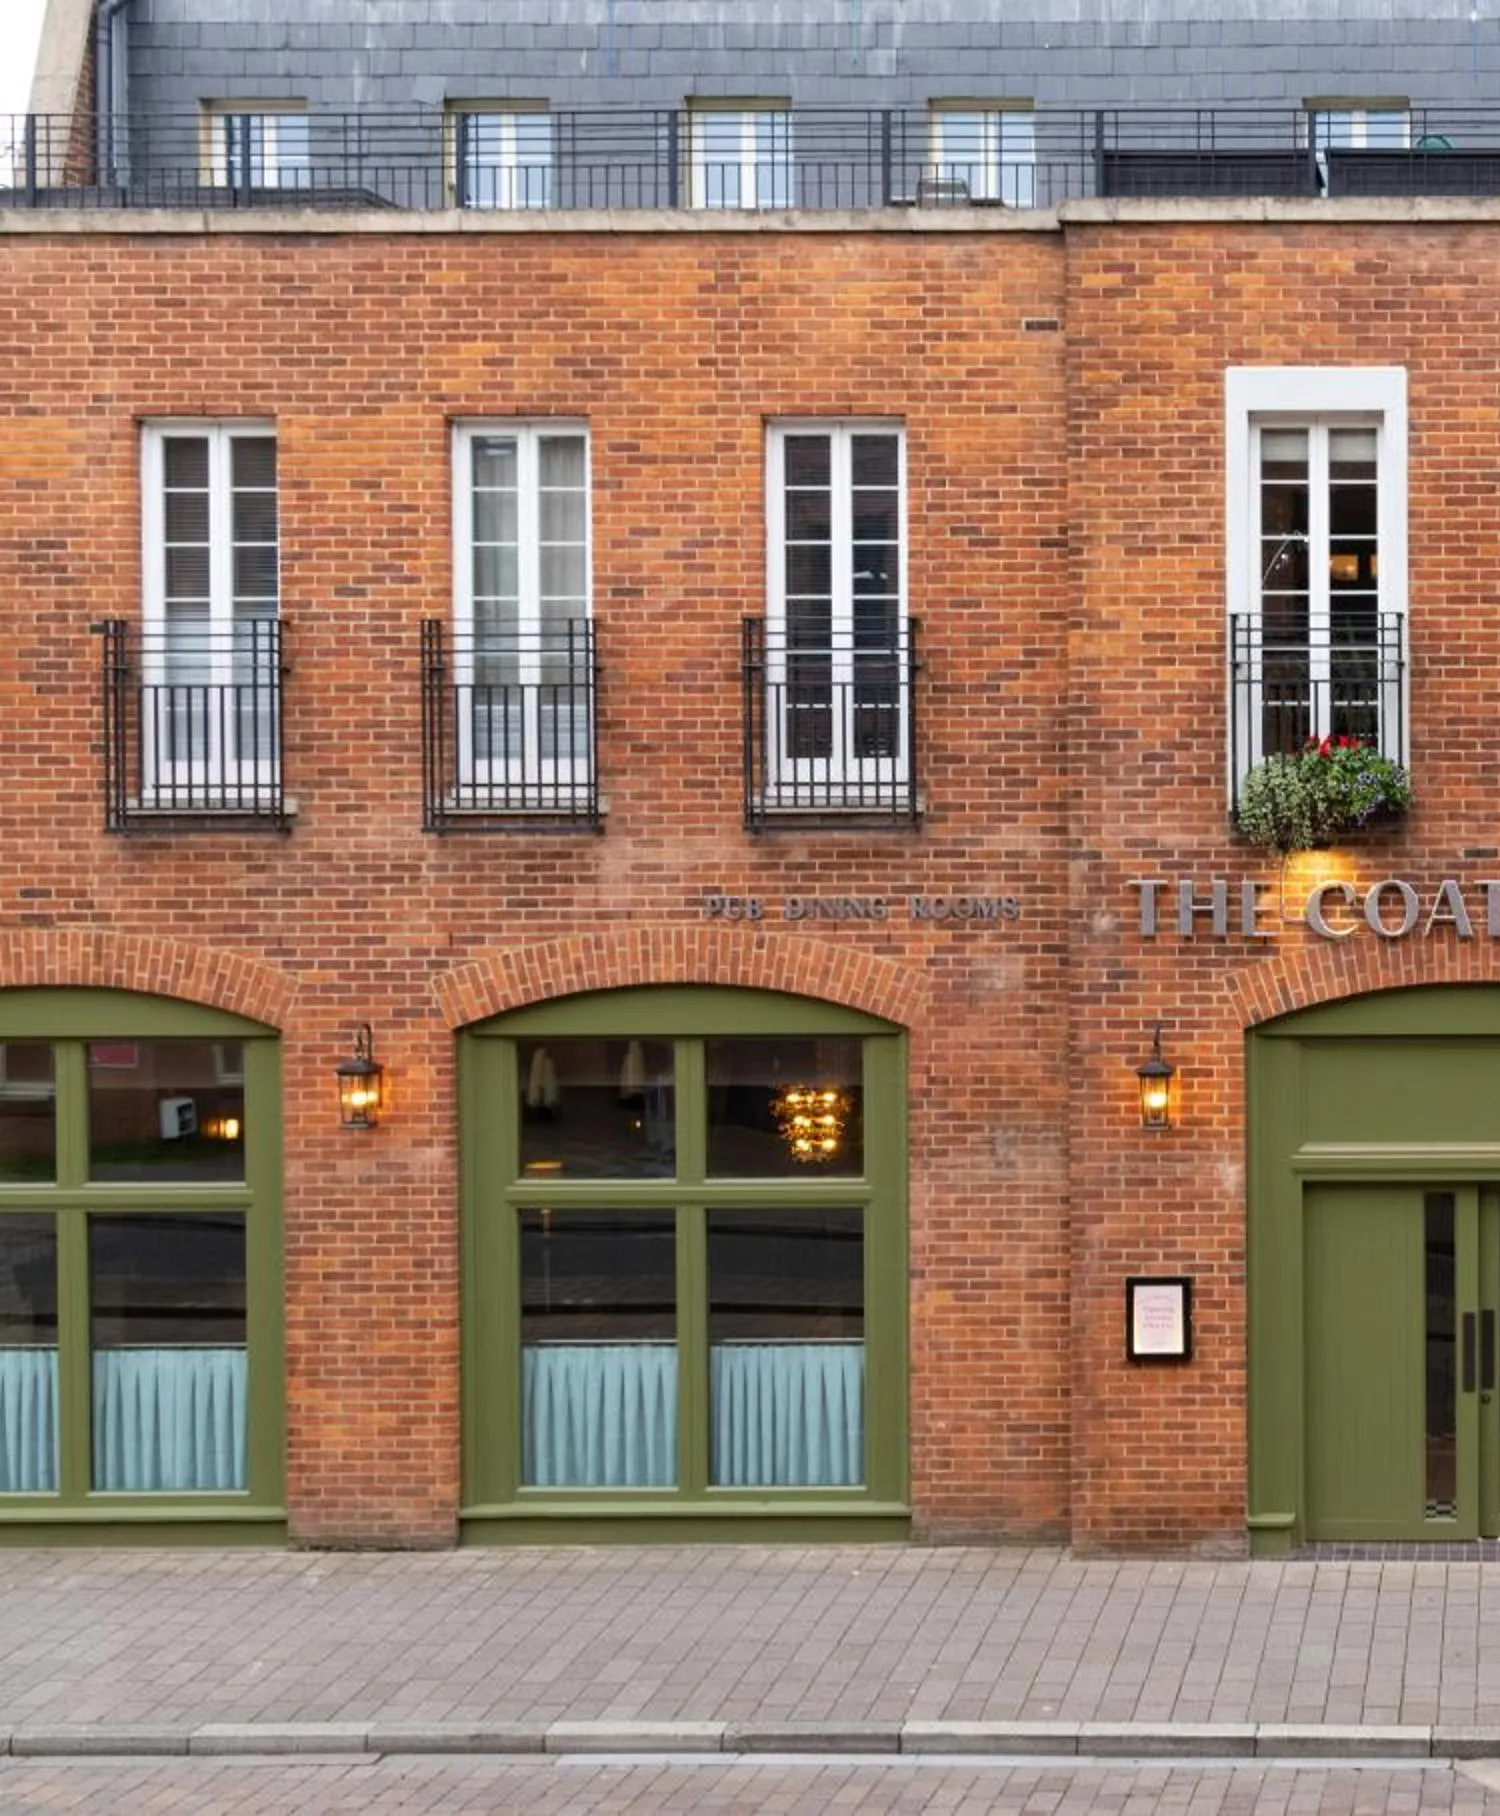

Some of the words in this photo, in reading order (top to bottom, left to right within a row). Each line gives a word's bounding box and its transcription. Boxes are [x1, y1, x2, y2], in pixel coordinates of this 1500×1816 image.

[703, 896, 764, 920] PUB
[784, 896, 888, 920] DINING
[910, 896, 1020, 920] ROOMS
[1126, 879, 1276, 937] THE
